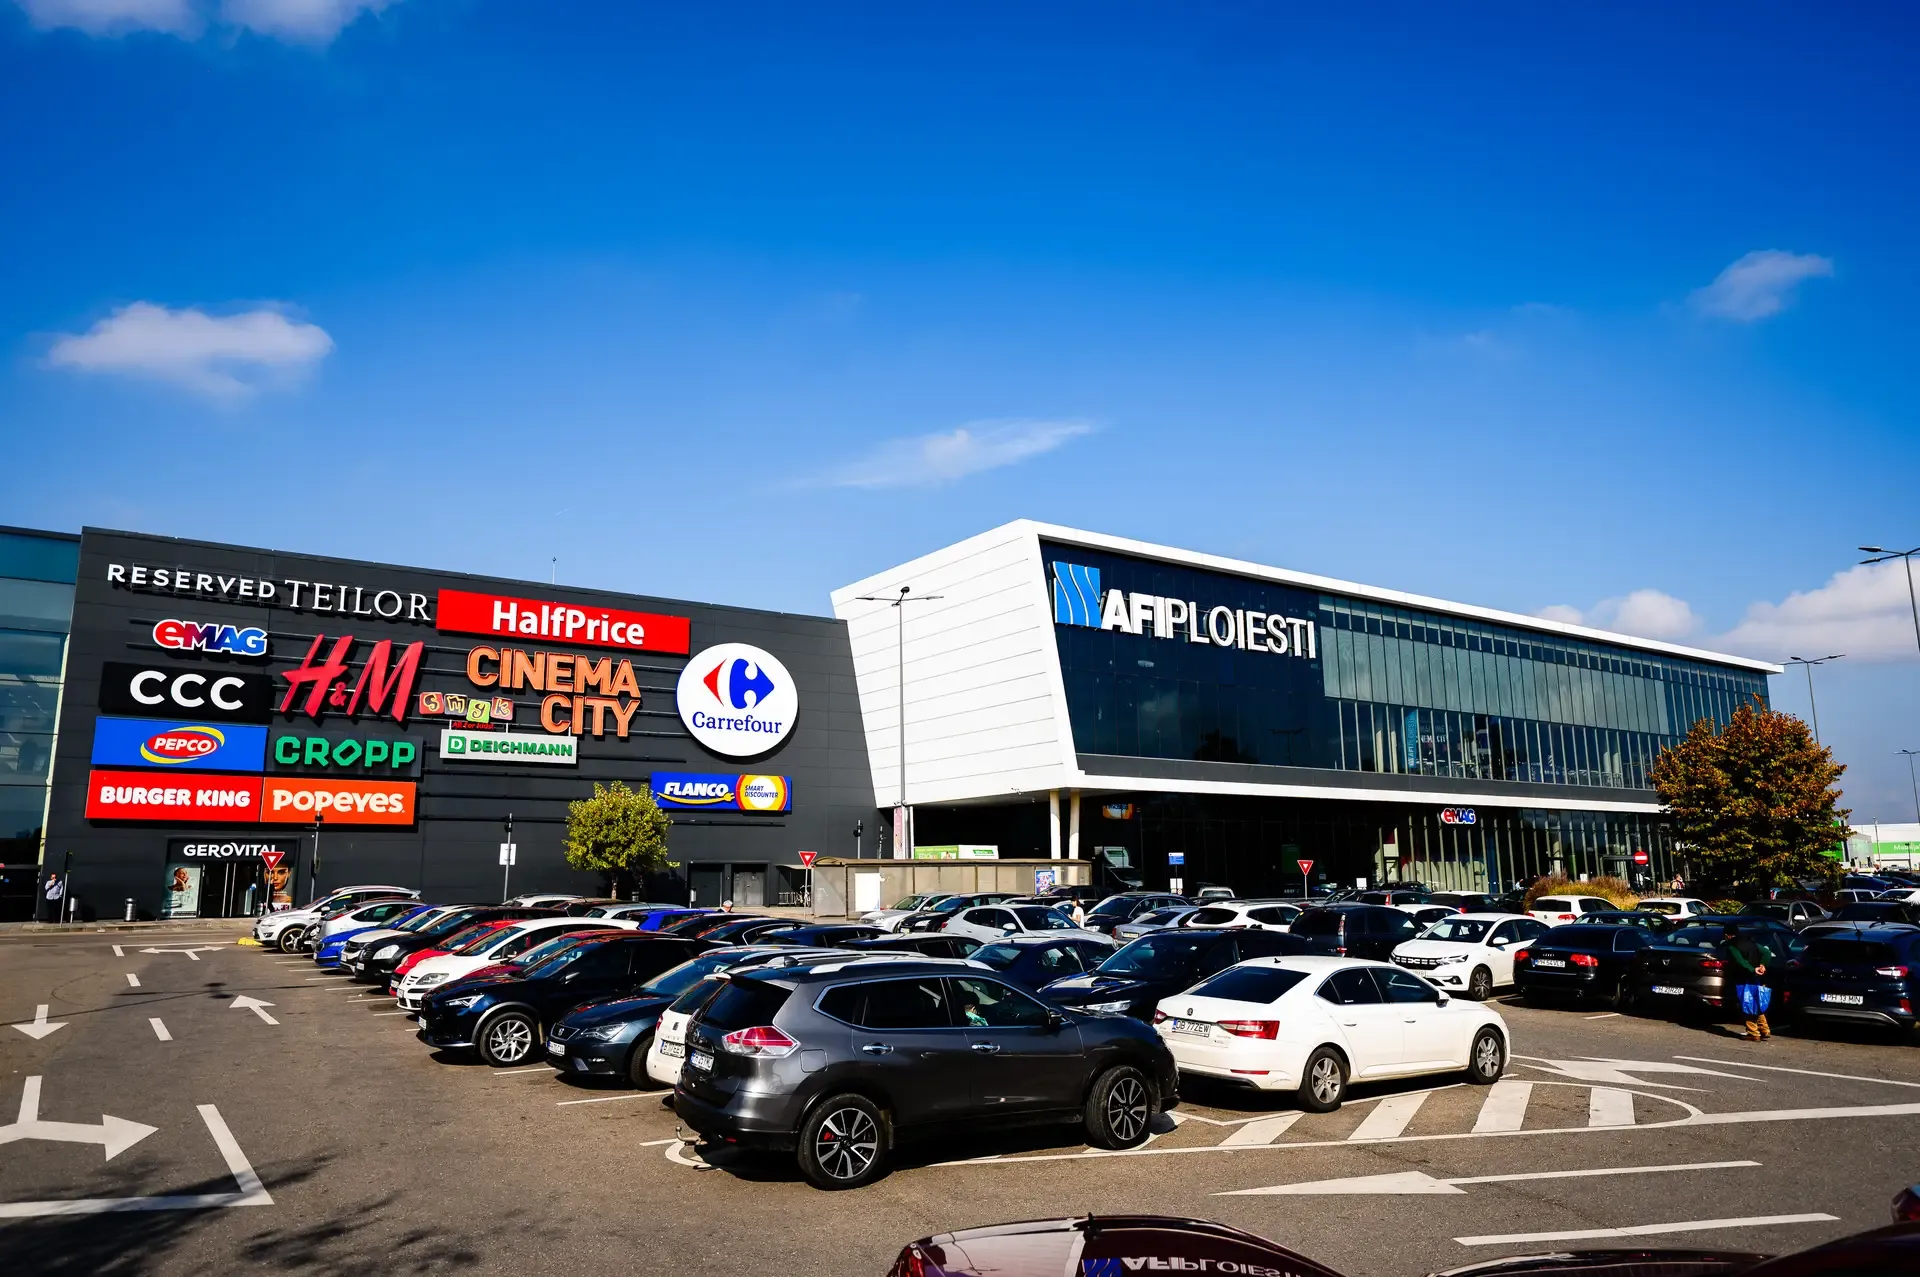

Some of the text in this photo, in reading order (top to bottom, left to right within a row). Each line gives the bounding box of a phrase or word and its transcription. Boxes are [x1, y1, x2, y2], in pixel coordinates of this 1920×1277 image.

[107, 563, 276, 599] RESERVED
[284, 579, 431, 622] TEILOR
[153, 618, 268, 657] eMAG
[491, 599, 645, 646] HalfPrice
[280, 633, 425, 722] H&M
[466, 645, 642, 698] CINEMA
[129, 670, 246, 711] CCC
[540, 693, 641, 738] CITY
[692, 711, 783, 734] Carrefour
[153, 737, 212, 754] PEPCO
[274, 735, 416, 769] CROPP
[470, 739, 573, 756] DEICHMANN
[100, 786, 251, 808] BURGER KING
[664, 782, 729, 797] FLANCO
[744, 784, 764, 792] SMART
[744, 791, 779, 799] DISCOUNTER
[1441, 807, 1477, 825] eMAG
